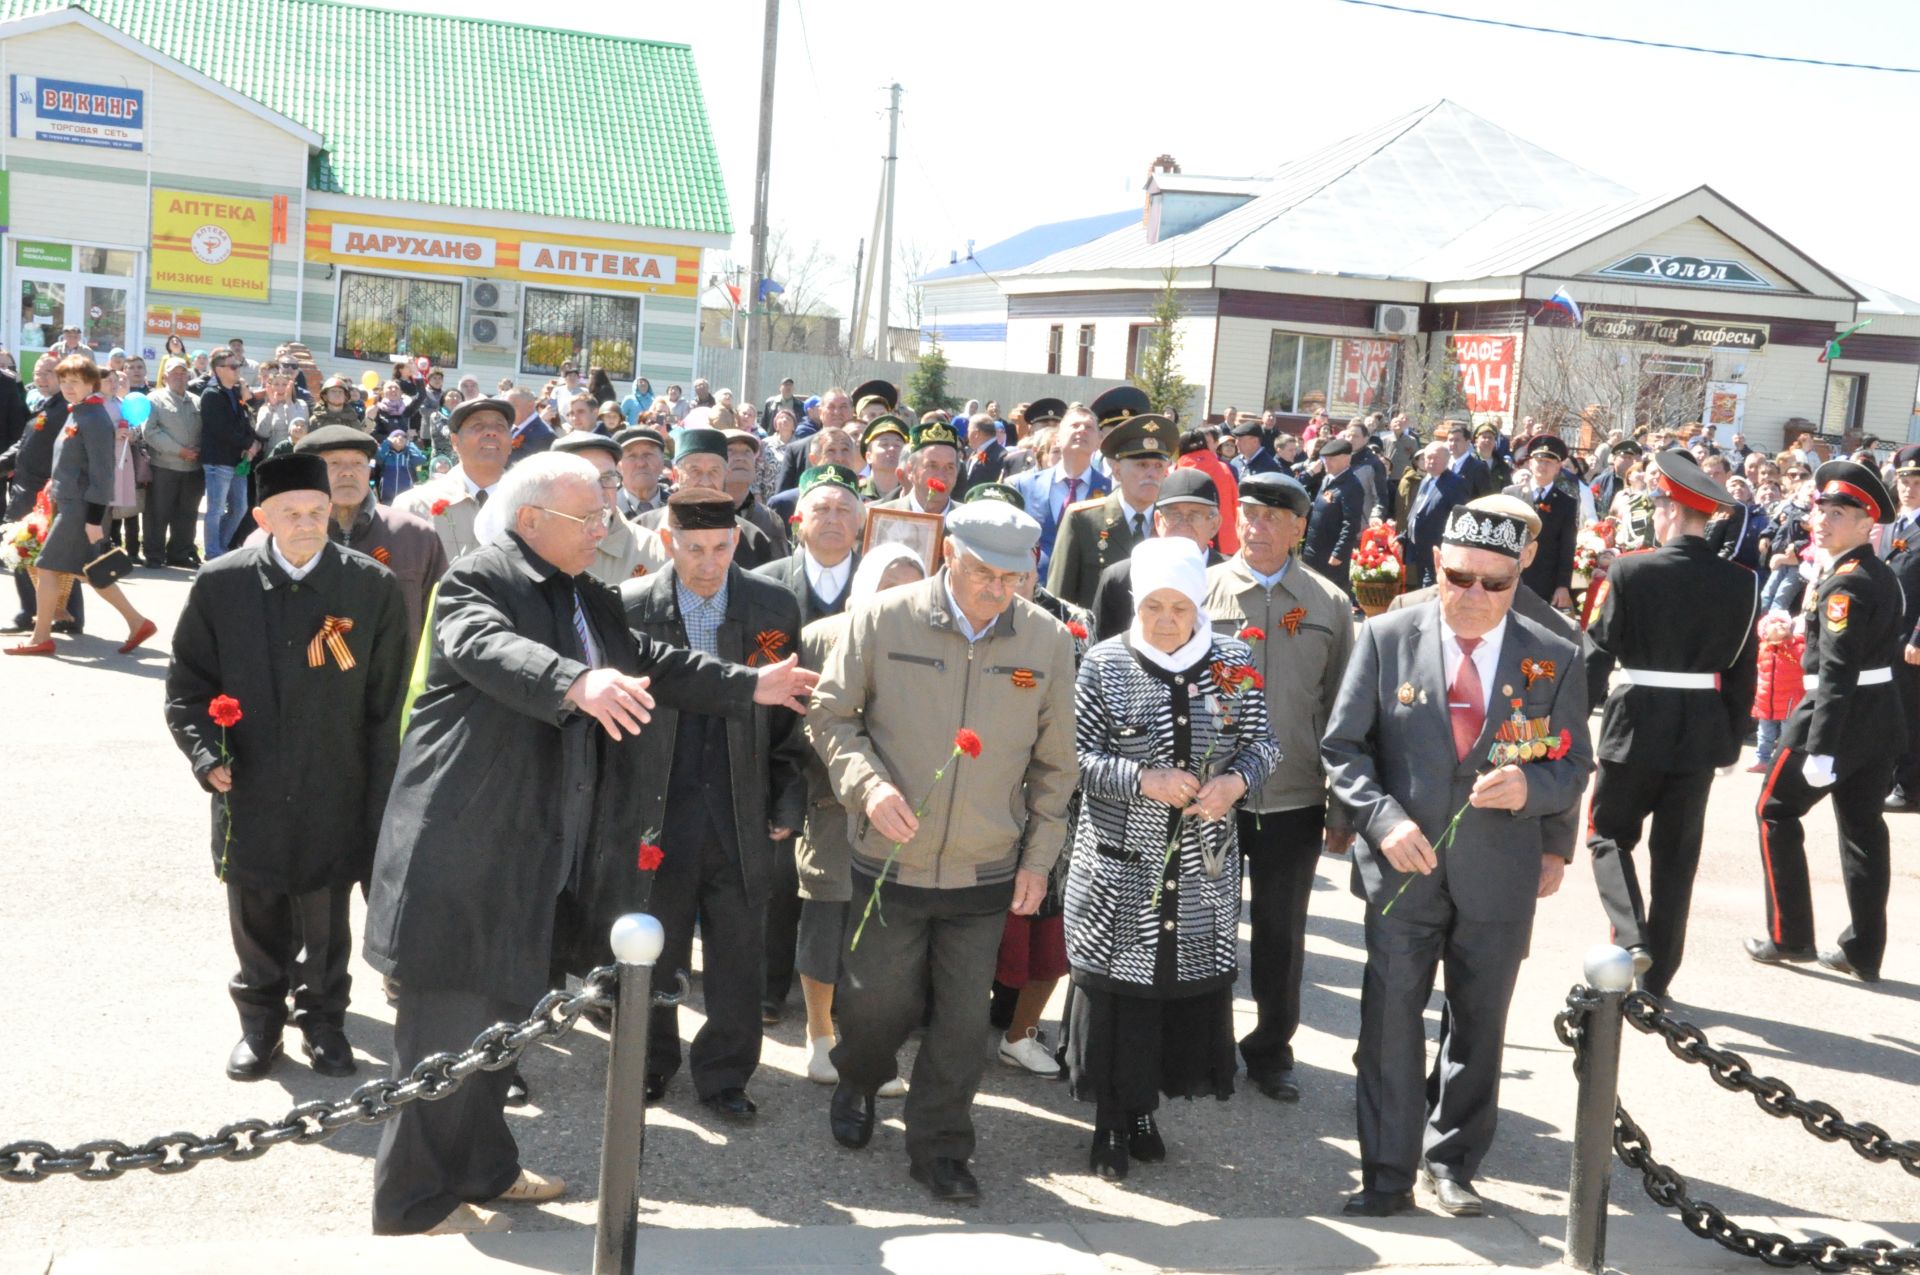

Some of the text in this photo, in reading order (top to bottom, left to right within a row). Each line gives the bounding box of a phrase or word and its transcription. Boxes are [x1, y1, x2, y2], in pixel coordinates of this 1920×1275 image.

[43, 89, 138, 119] ВИКИНГ
[50, 123, 128, 138] ТОРГОВАЯ СЕТЬ
[168, 198, 257, 222] АПТЕКА
[345, 231, 482, 260] ДАРУХАНӘ
[534, 248, 661, 279] АПТЕКА
[1644, 256, 1727, 280] Хәләл
[156, 271, 264, 290] НИЗКИЕ ЦЕНЫ
[176, 321, 199, 331] 8-20
[1593, 319, 1636, 338] кафе
[1693, 327, 1757, 346] кафесы
[1456, 340, 1503, 361] КАФЕ
